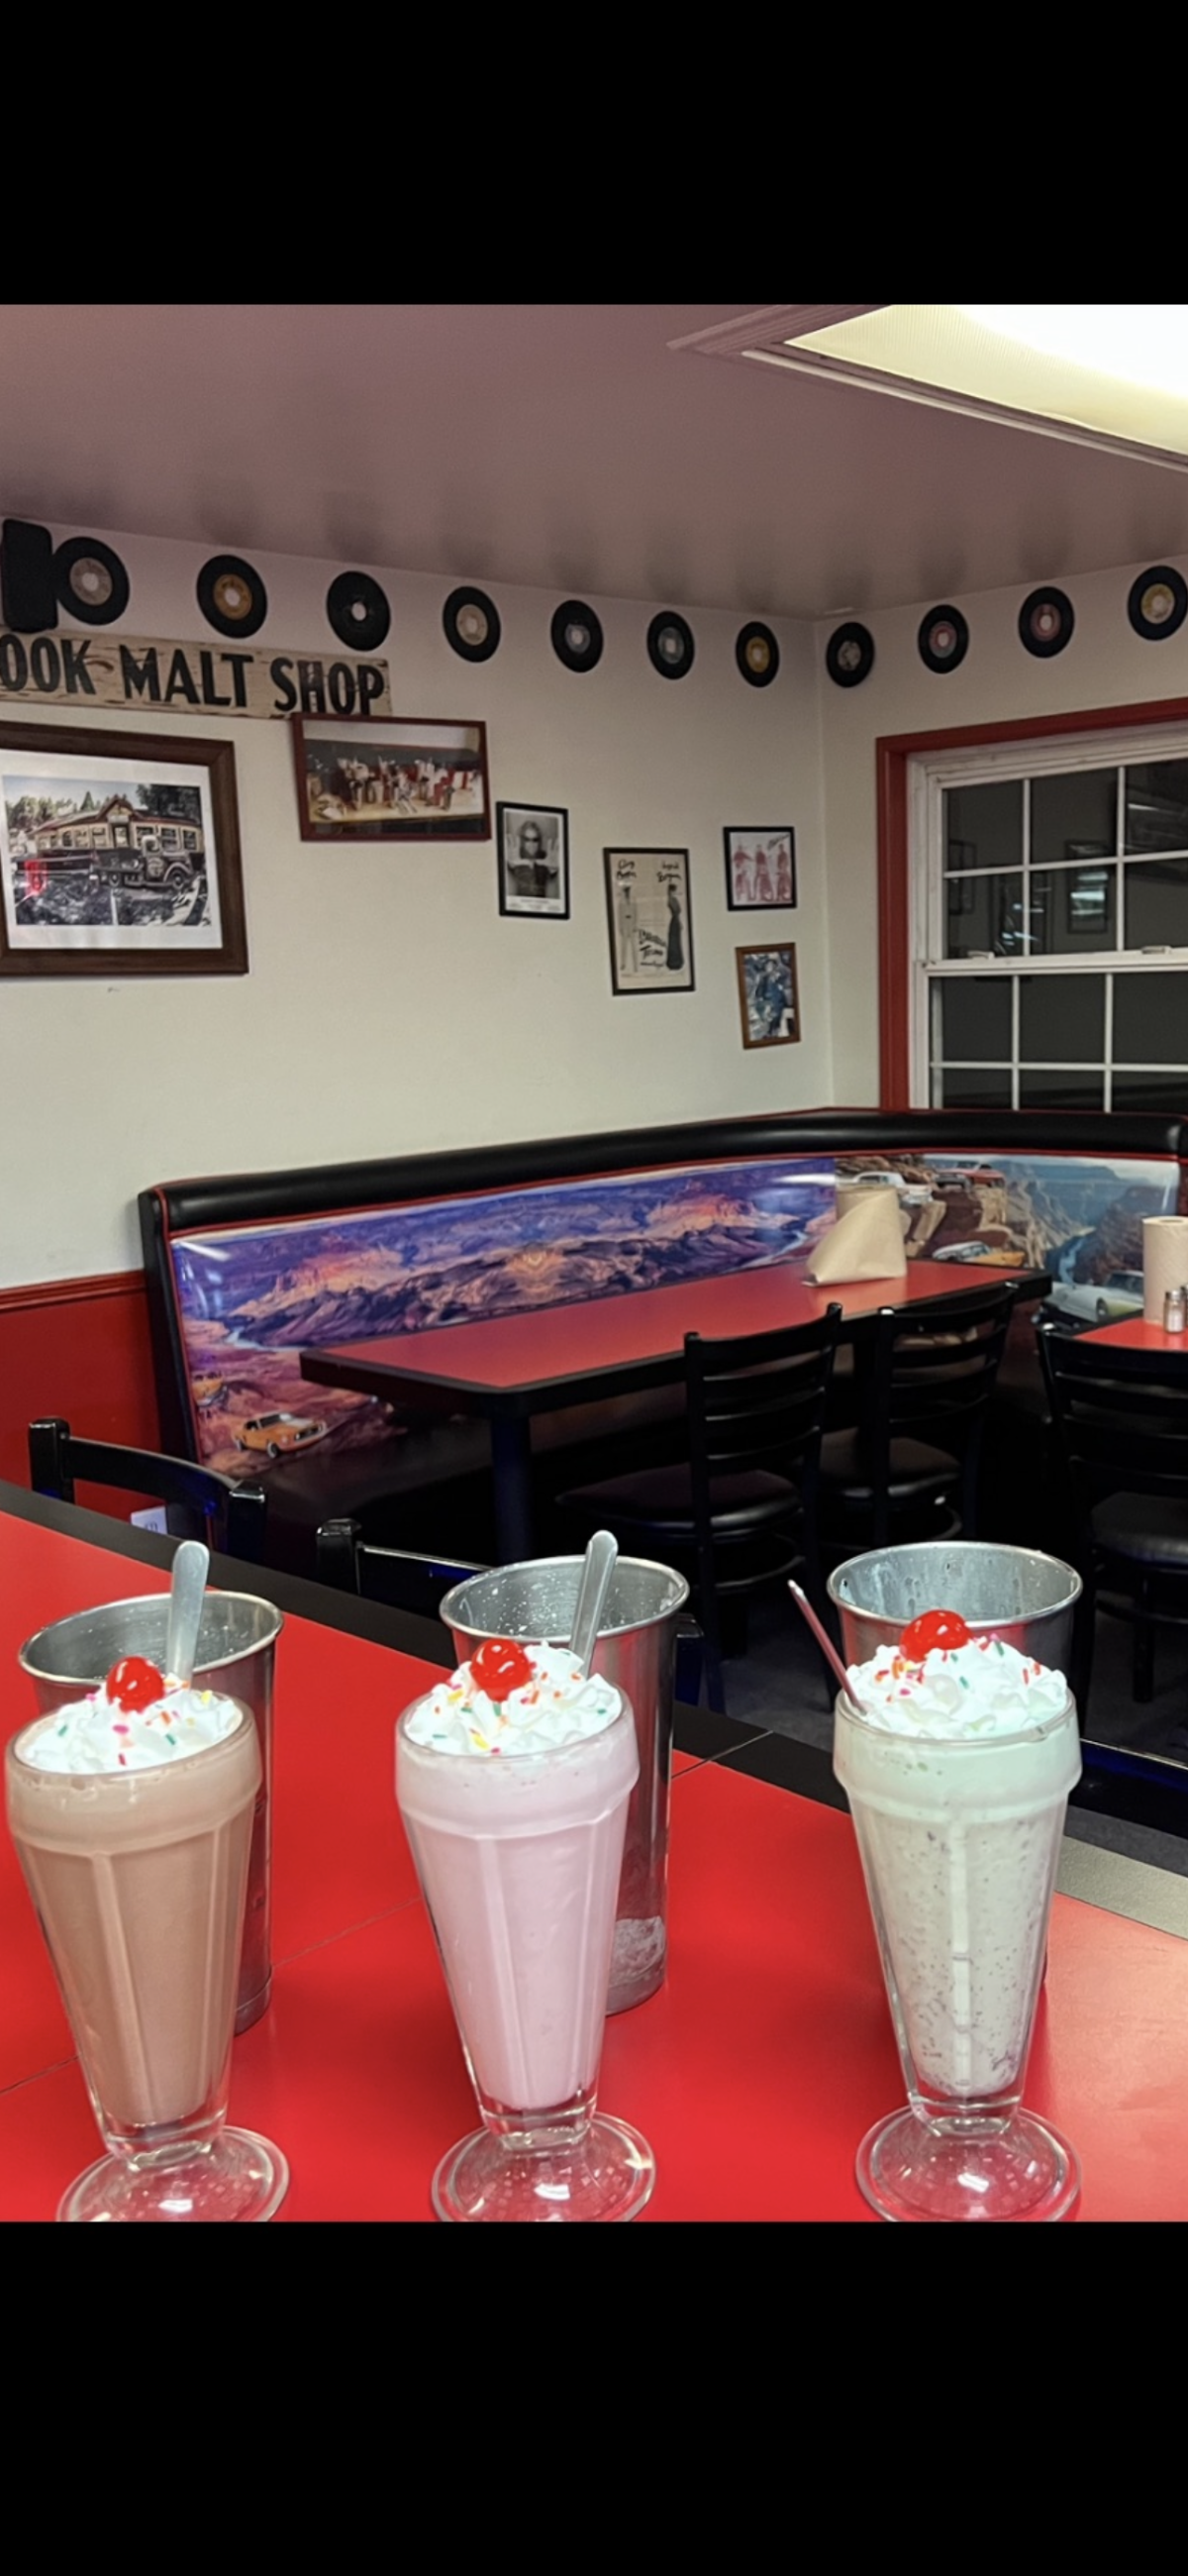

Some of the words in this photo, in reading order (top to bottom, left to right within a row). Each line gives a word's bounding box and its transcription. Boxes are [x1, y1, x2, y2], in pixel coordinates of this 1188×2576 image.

[0, 634, 97, 694] OOK
[119, 644, 254, 707] MALT
[270, 657, 384, 715] SHOP
